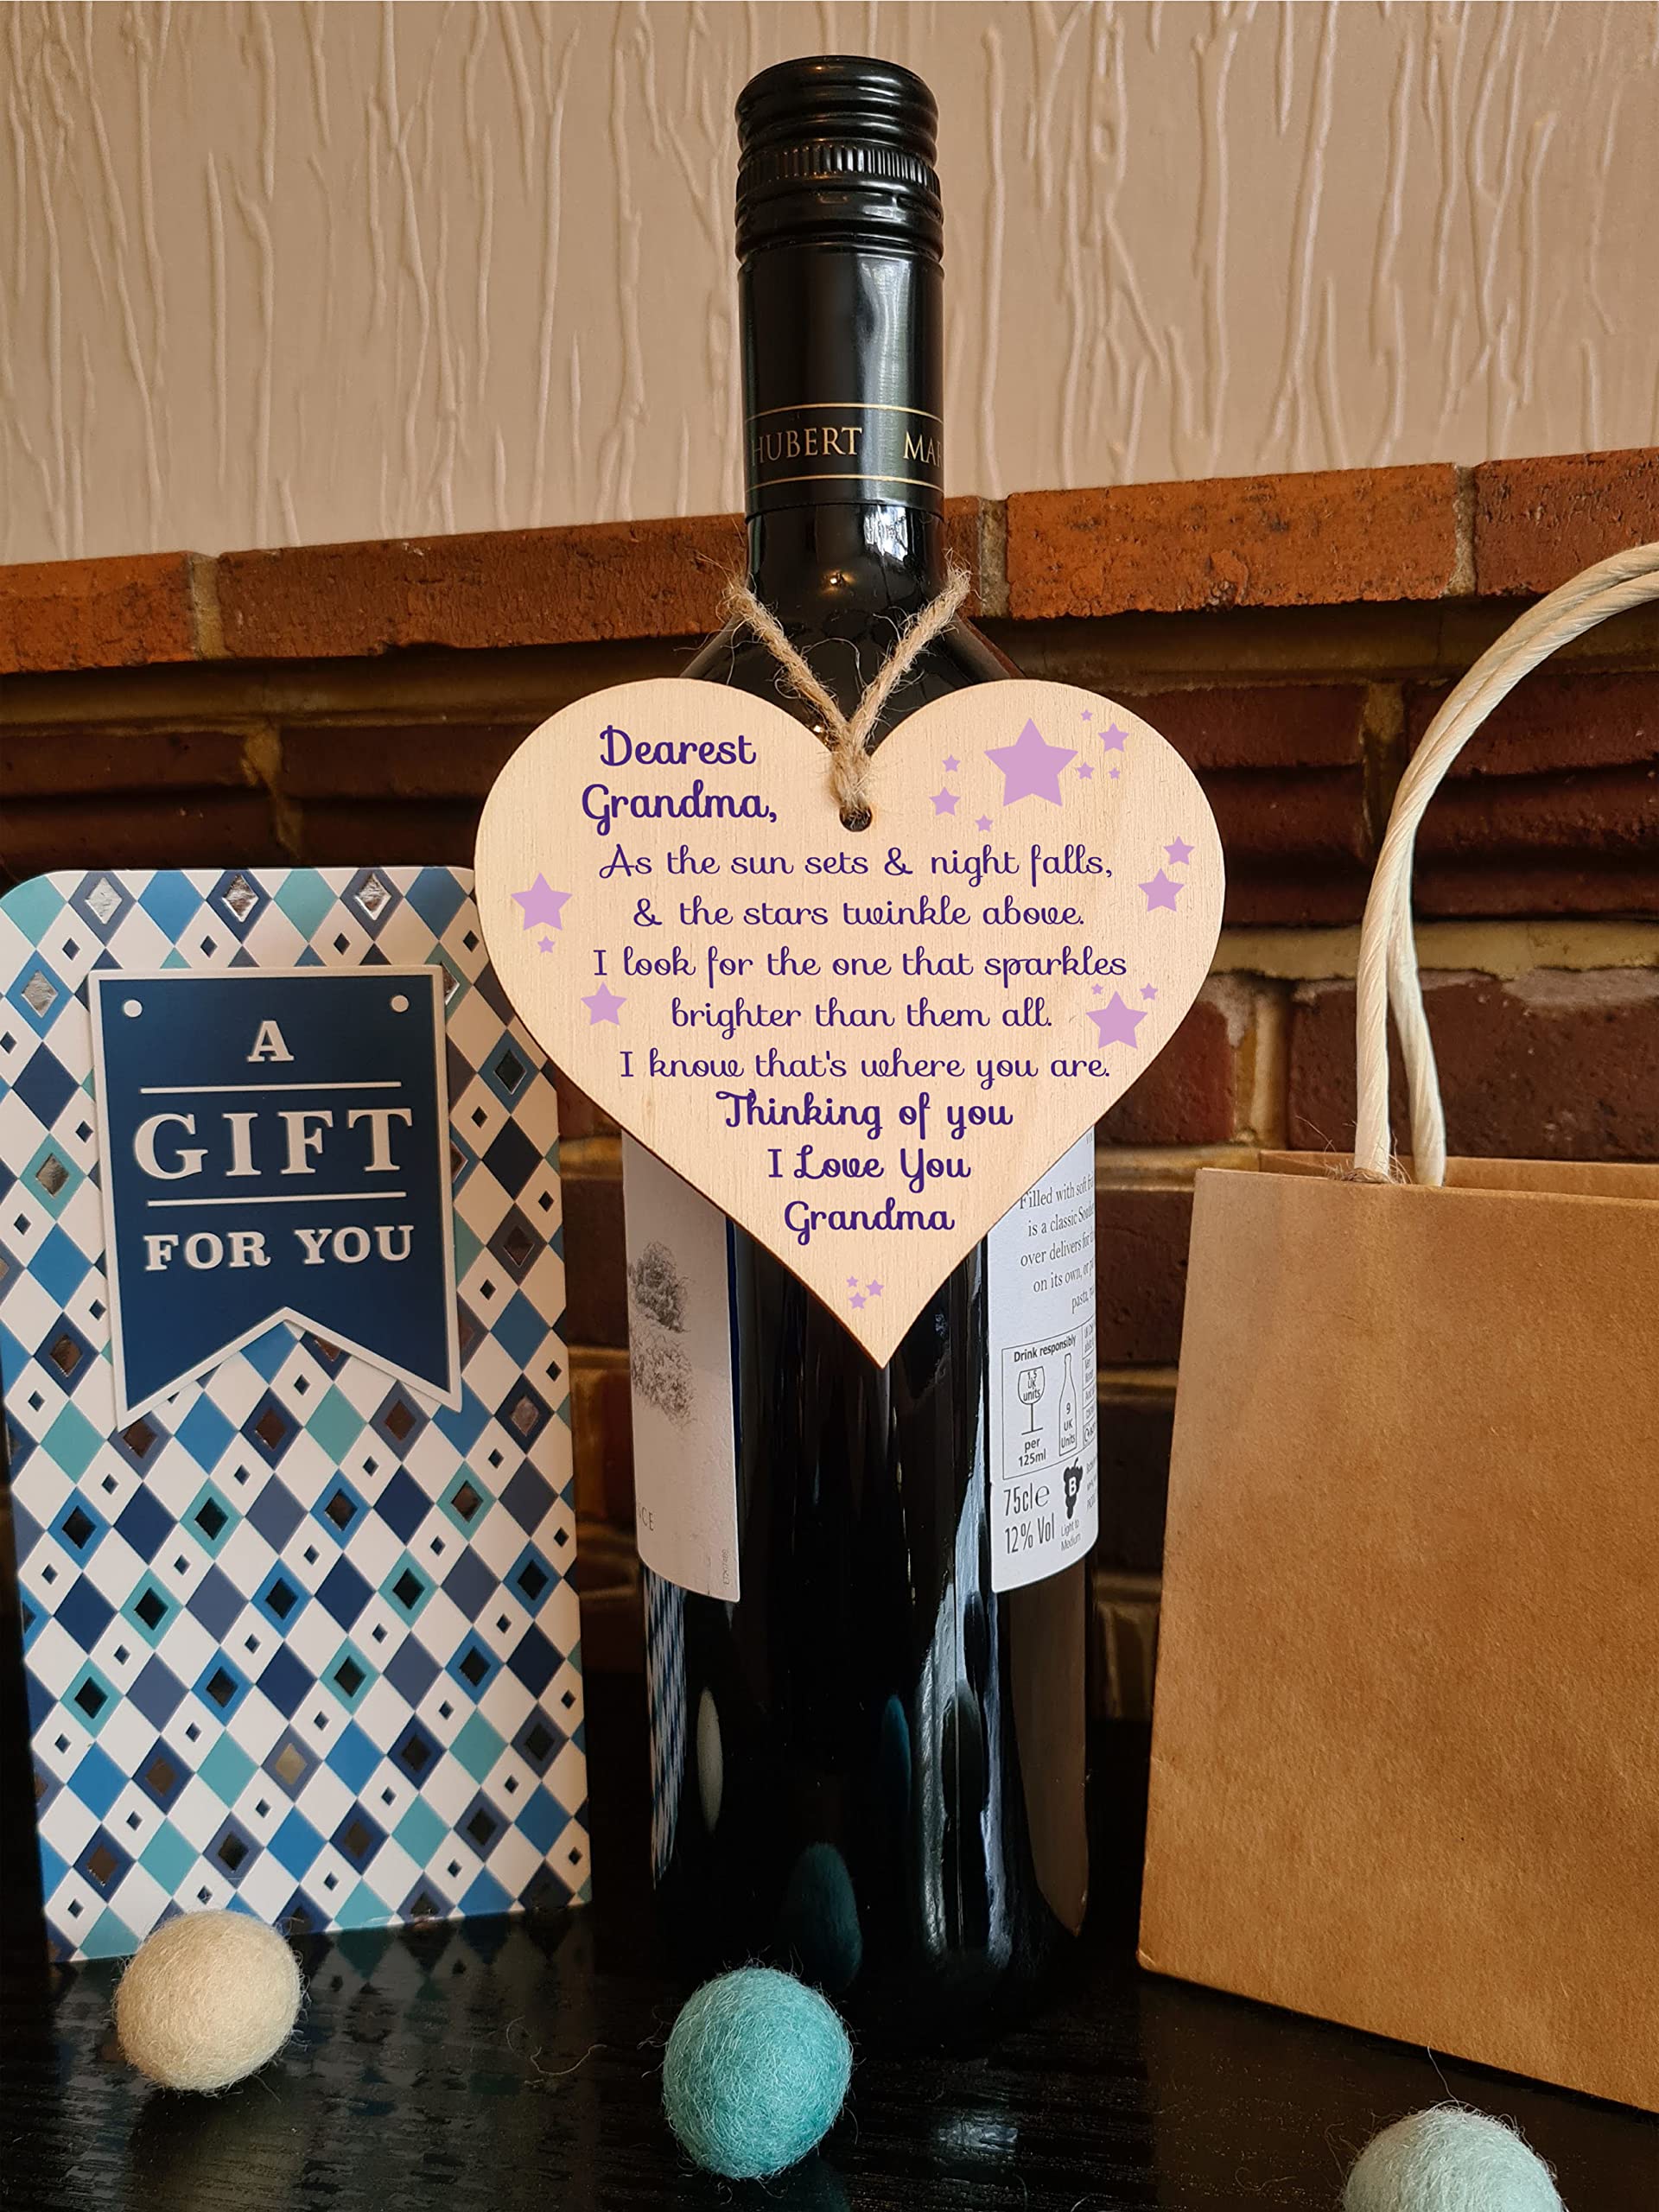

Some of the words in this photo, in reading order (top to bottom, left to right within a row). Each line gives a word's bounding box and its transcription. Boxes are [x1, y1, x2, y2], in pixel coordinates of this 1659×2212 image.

[752, 427, 862, 467] HUBERT
[599, 724, 757, 766] Dearest
[582, 779, 777, 836] Grandma,
[599, 843, 652, 879] As
[667, 844, 721, 874] the
[730, 856, 794, 874] sun
[804, 851, 868, 874] sets
[884, 847, 913, 876] &
[931, 844, 1020, 887] night
[1031, 844, 1112, 887] falls,
[633, 898, 663, 927] &
[679, 894, 734, 925] the
[743, 902, 829, 925] stars
[842, 894, 971, 925] twinkle
[982, 894, 1084, 925] above.
[594, 950, 607, 976] I
[623, 945, 696, 976] look
[708, 945, 753, 989] for
[767, 945, 820, 976] the
[832, 958, 892, 976] one
[902, 945, 974, 976] that
[984, 945, 1127, 989] sparkles
[671, 997, 802, 1039] brighter
[815, 996, 895, 1027] than
[906, 996, 990, 1027] them
[1001, 996, 1052, 1027] all.
[246, 1020, 295, 1062] A
[620, 1051, 634, 1077] I
[649, 1047, 744, 1077] know
[755, 1047, 847, 1077] that's
[861, 1047, 965, 1077] where
[976, 1059, 1038, 1090] you
[1050, 1059, 1110, 1077] are.
[715, 1088, 883, 1140] Thinking
[899, 1091, 930, 1141] of
[946, 1105, 1014, 1140] you
[134, 1108, 413, 1180] GIFT
[767, 1148, 783, 1178] I
[793, 1144, 885, 1179] Love
[899, 1147, 971, 1194] You
[1020, 1186, 1052, 1210] Filled
[1056, 1181, 1075, 1202] with
[784, 1197, 956, 1246] Grandma
[1028, 1220, 1038, 1236] is
[1041, 1222, 1047, 1234] a
[1050, 1209, 1077, 1232] classic
[143, 1231, 271, 1272] FOR
[294, 1224, 415, 1265] YOU
[1020, 1250, 1046, 1267] over
[1050, 1240, 1082, 1261] delivers
[1033, 1279, 1047, 1293] on
[1051, 1271, 1063, 1288] its
[1014, 1347, 1038, 1363] Drink
[1039, 1333, 1077, 1356] responsibly
[1023, 1389, 1041, 1401] units
[1065, 1402, 1071, 1414] 9
[1061, 1434, 1076, 1448] Units
[1064, 1418, 1073, 1431] UK
[1019, 1448, 1046, 1467] 125ml
[1024, 1438, 1040, 1453] per
[1068, 1476, 1077, 1497] B
[1005, 1521, 1033, 1554] 12%
[1038, 1512, 1054, 1544] Vol
